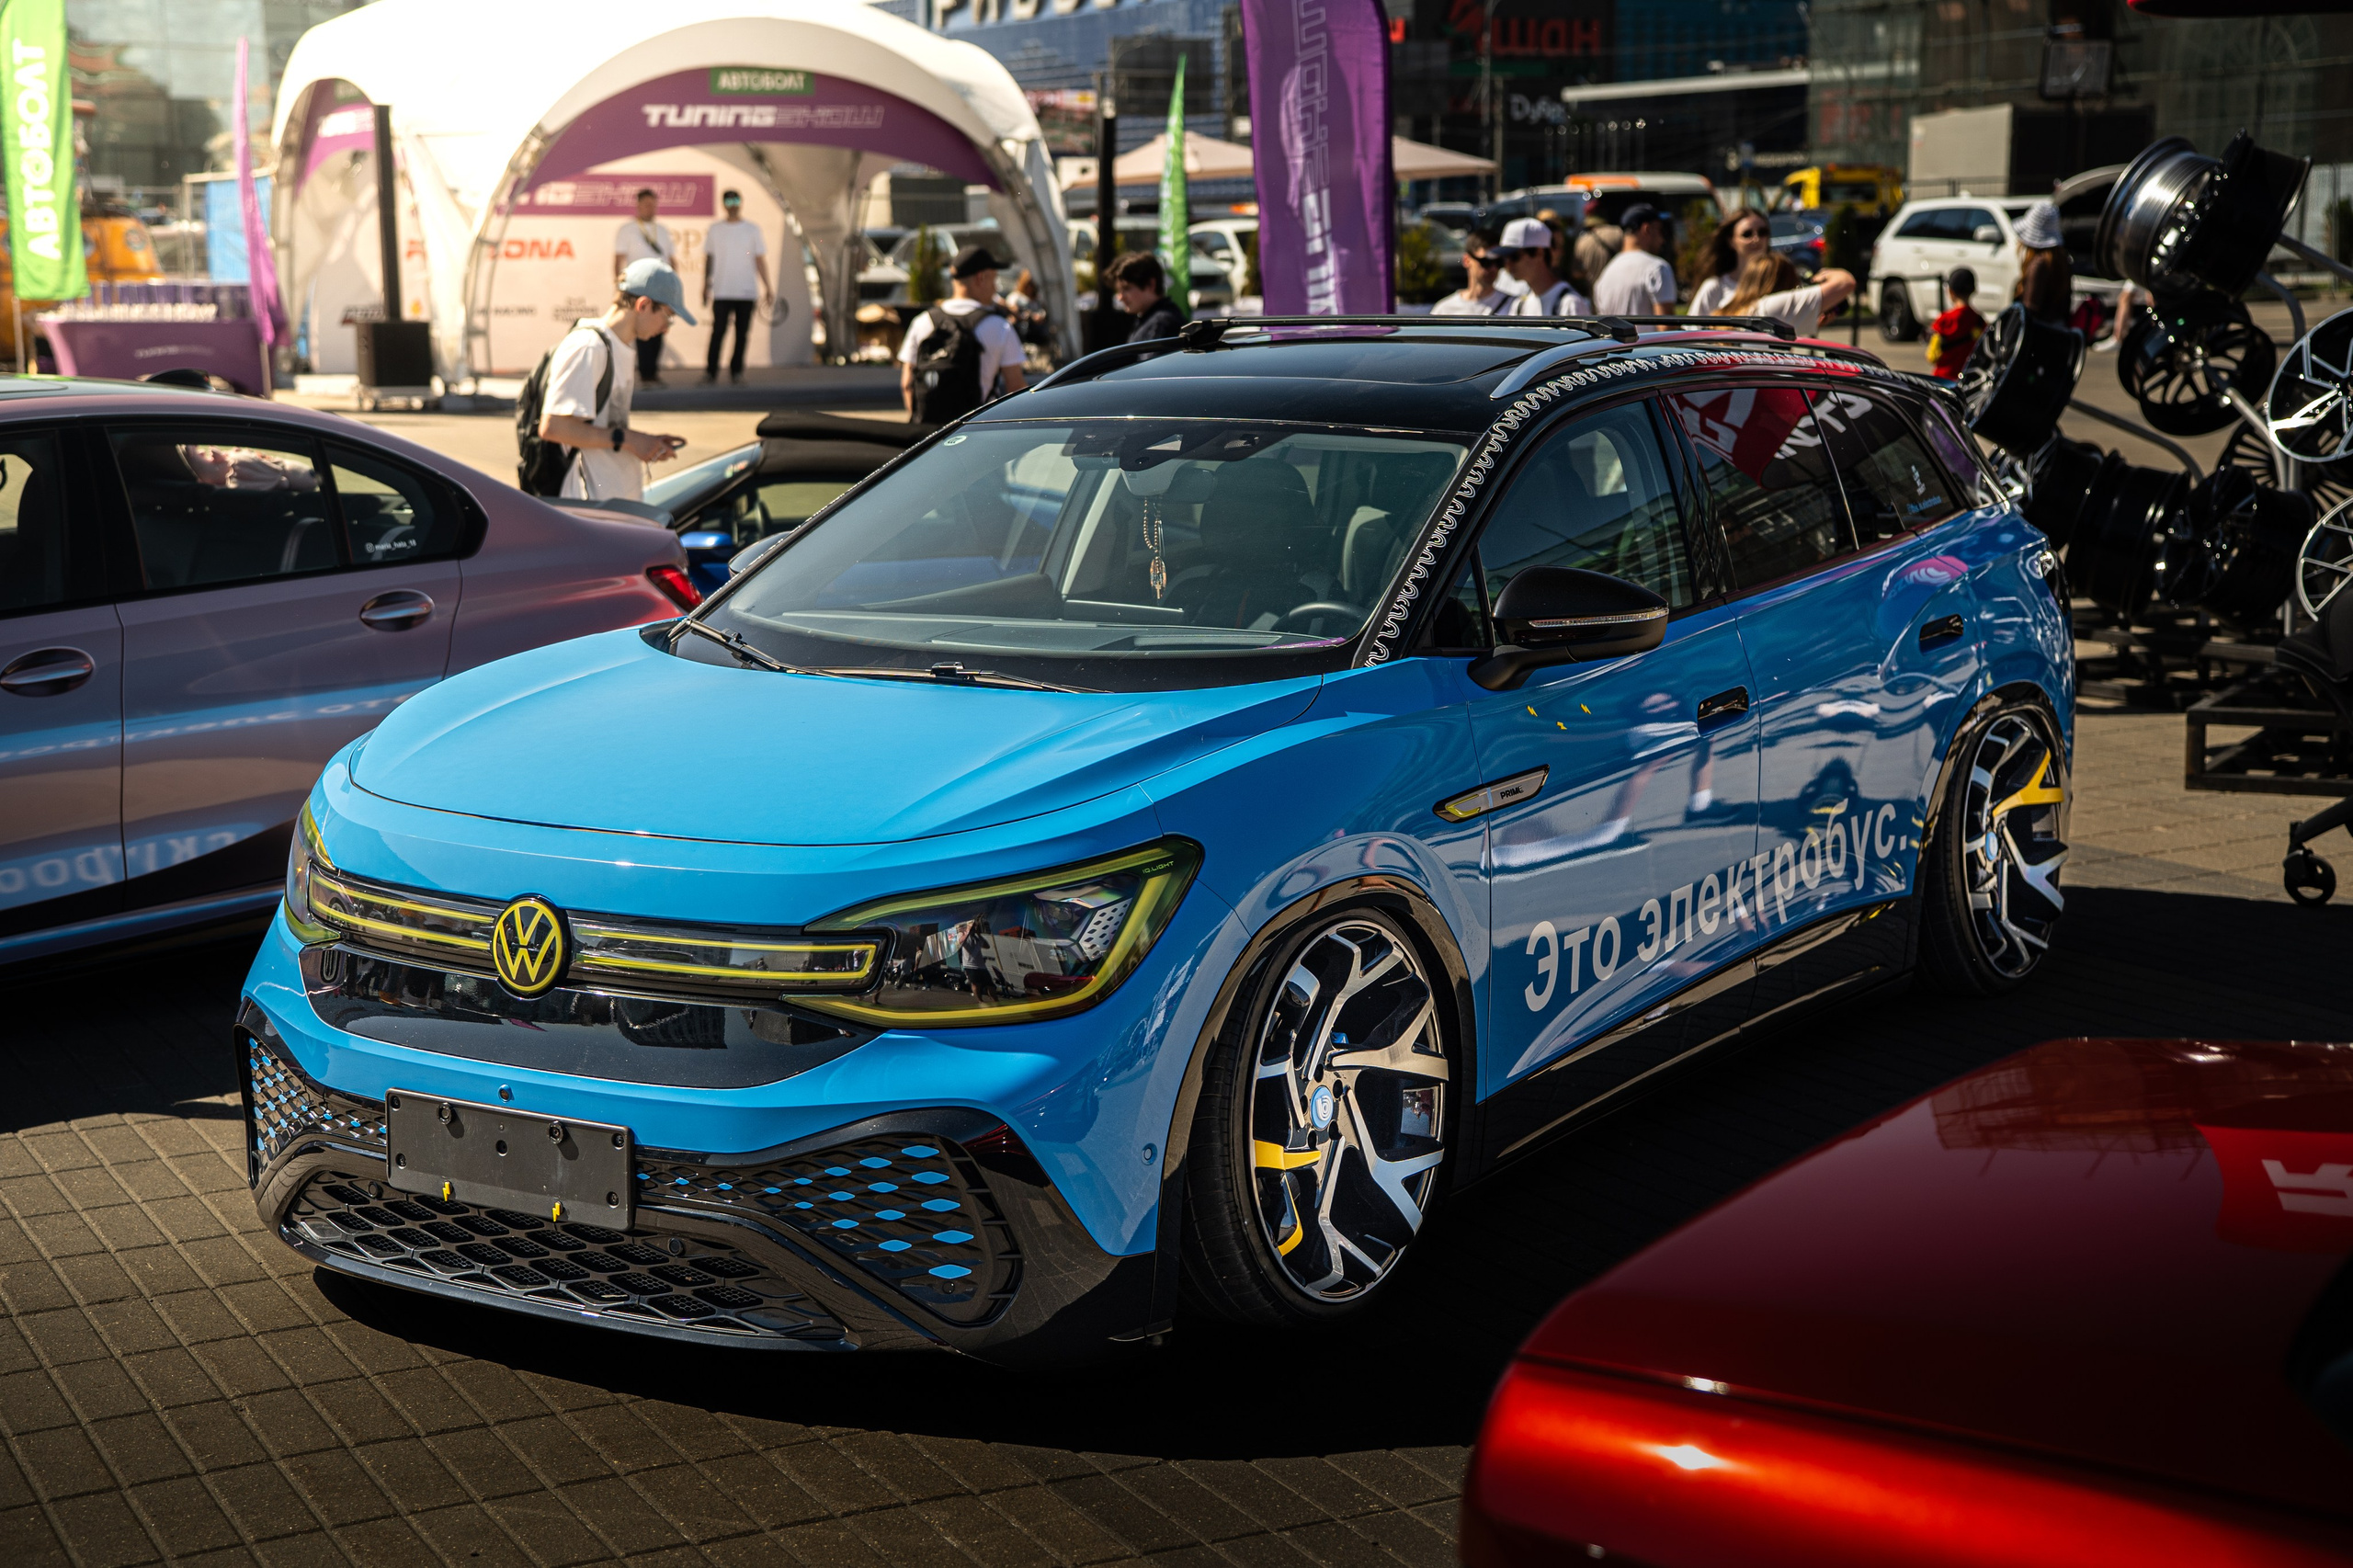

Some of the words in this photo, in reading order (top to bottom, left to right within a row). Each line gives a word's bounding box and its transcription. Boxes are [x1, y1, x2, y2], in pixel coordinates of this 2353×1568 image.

[717, 70, 807, 92] АВТОБОЛТ
[13, 38, 62, 261] АВТОБОЛТ
[1142, 860, 1175, 874] IQ.LIGHT
[1525, 915, 1621, 1012] Это
[1636, 798, 1908, 962] электробус.
